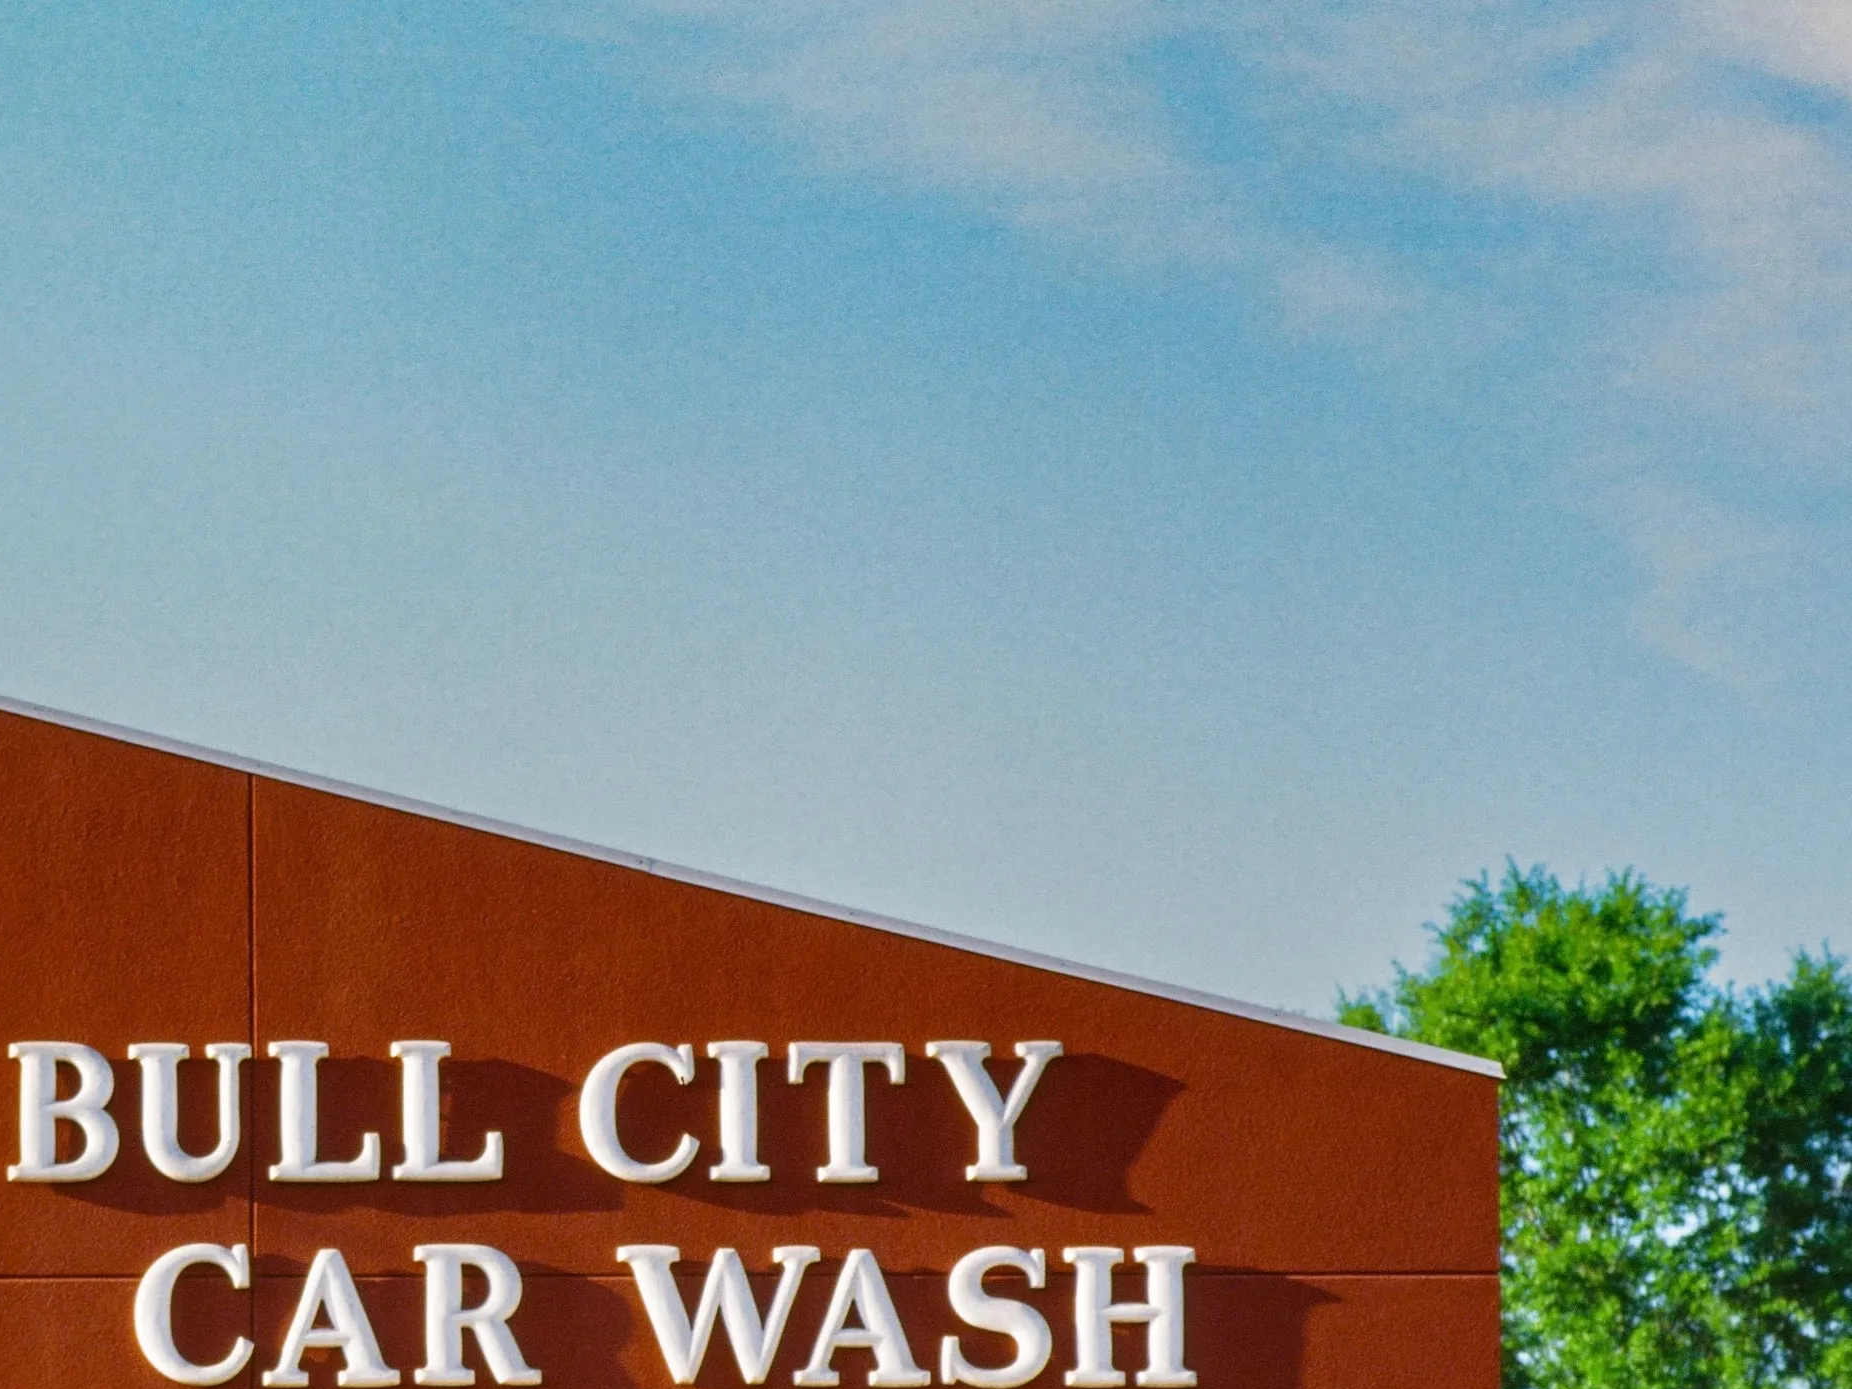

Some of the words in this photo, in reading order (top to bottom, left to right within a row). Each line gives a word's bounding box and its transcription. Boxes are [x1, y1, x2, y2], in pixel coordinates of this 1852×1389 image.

[7, 1039, 503, 1182] BULL
[578, 1040, 1063, 1183] CITY
[133, 1242, 542, 1386] CAR
[615, 1243, 1197, 1388] WASH
